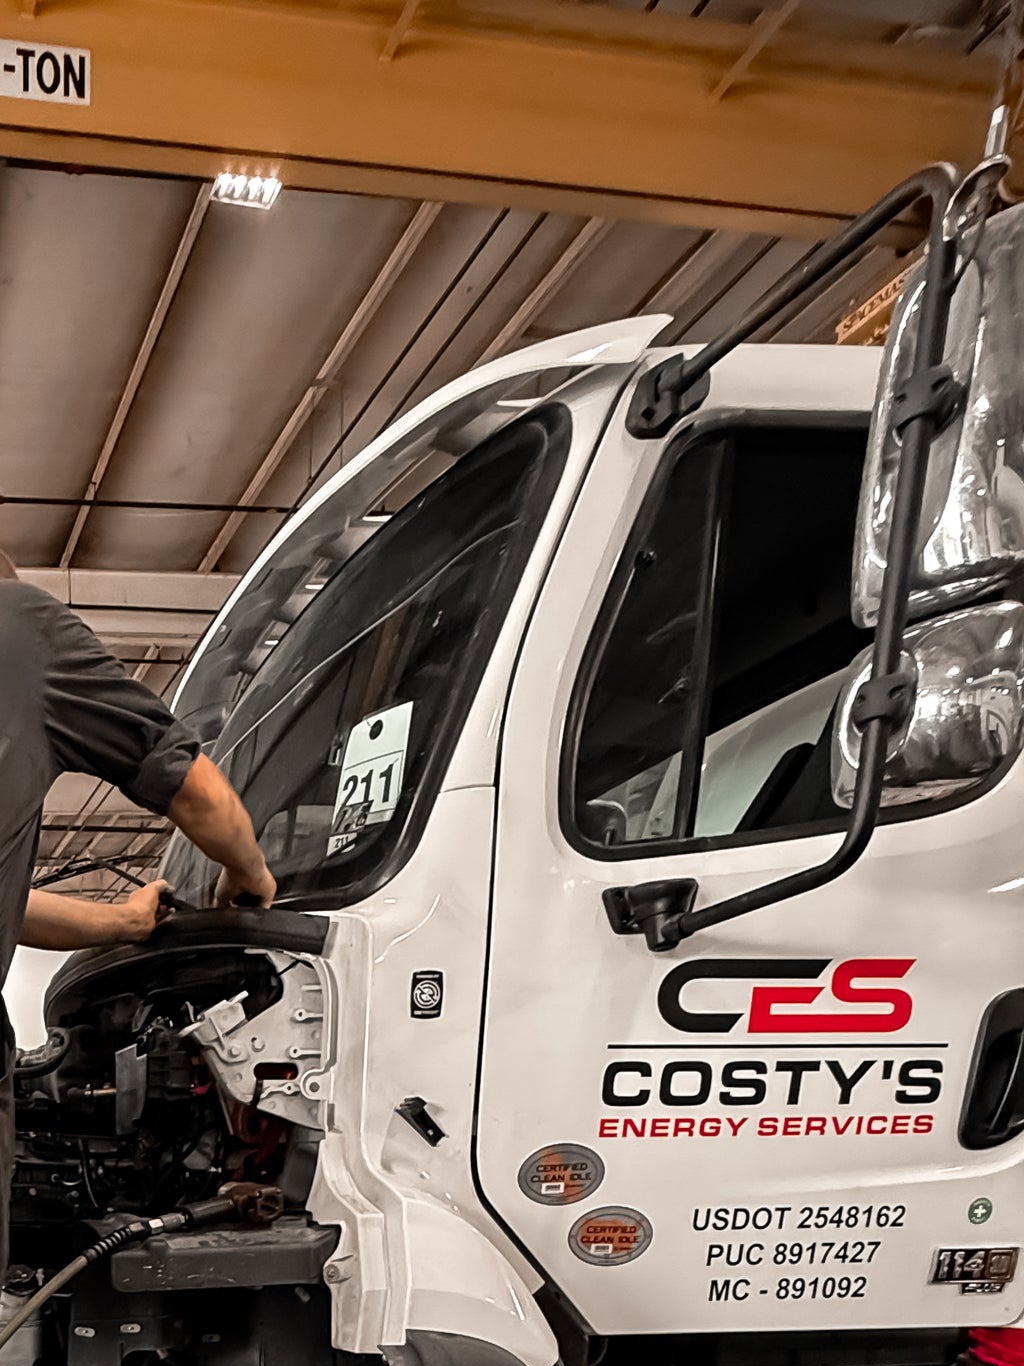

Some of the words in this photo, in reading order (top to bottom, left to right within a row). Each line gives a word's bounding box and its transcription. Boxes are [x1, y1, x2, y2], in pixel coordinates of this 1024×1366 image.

[339, 763, 394, 808] 211
[657, 958, 917, 1034] CES
[602, 1060, 944, 1107] COSTY'S
[598, 1117, 749, 1138] ENERGY
[757, 1115, 934, 1137] SERVICES
[530, 1174, 565, 1184] CLEAN
[569, 1171, 592, 1181] IDLE
[536, 1162, 588, 1173] CERTIFIED
[586, 1225, 637, 1234] CERTIFIED
[692, 1206, 792, 1231] USDOT
[796, 1205, 906, 1229] 2548162
[580, 1235, 614, 1244] CLEAN
[617, 1235, 639, 1244] IDLE
[706, 1243, 764, 1267] PUC
[772, 1241, 881, 1265] 8917427
[708, 1278, 751, 1302] MC
[775, 1276, 867, 1300] 891092
